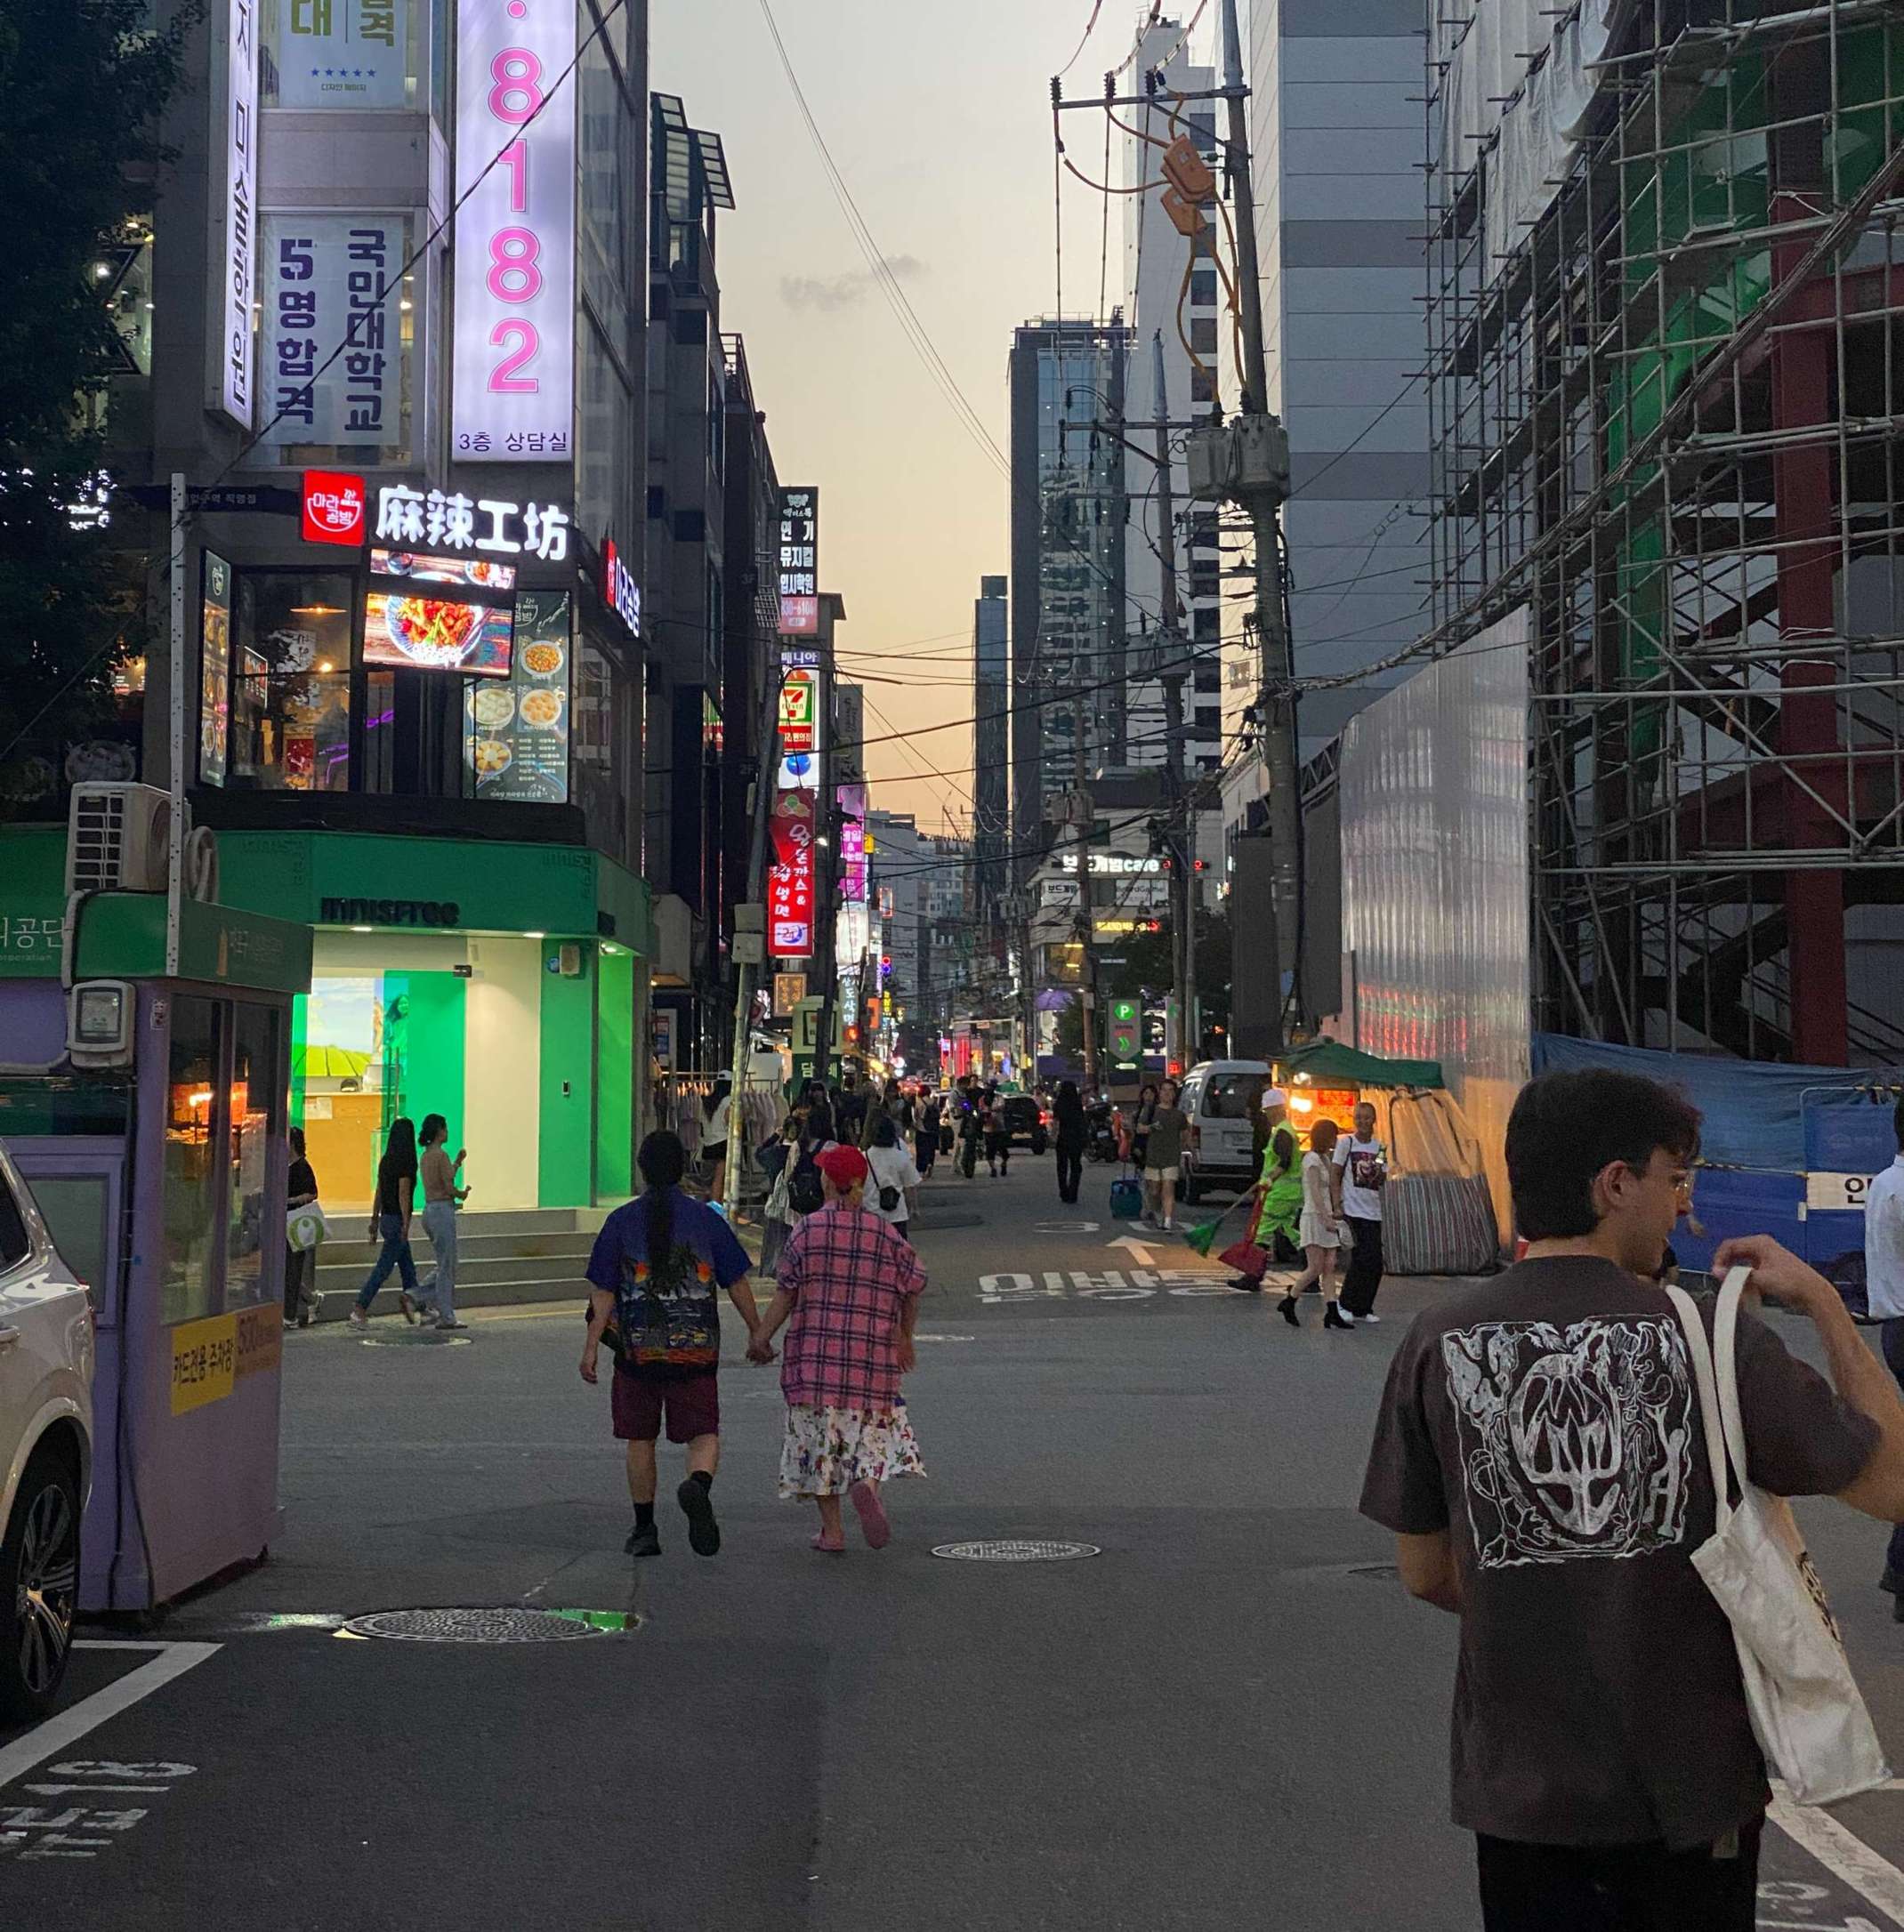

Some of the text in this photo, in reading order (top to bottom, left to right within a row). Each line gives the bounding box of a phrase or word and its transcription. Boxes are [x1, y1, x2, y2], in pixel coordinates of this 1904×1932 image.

[344, 229, 386, 431] 국민대학교
[459, 431, 567, 453] 3층 상담실
[375, 485, 569, 561] 麻辣工坊
[780, 546, 813, 568] 뮤지컬
[780, 574, 813, 595] 입시학원
[1120, 1005, 1130, 1018] P
